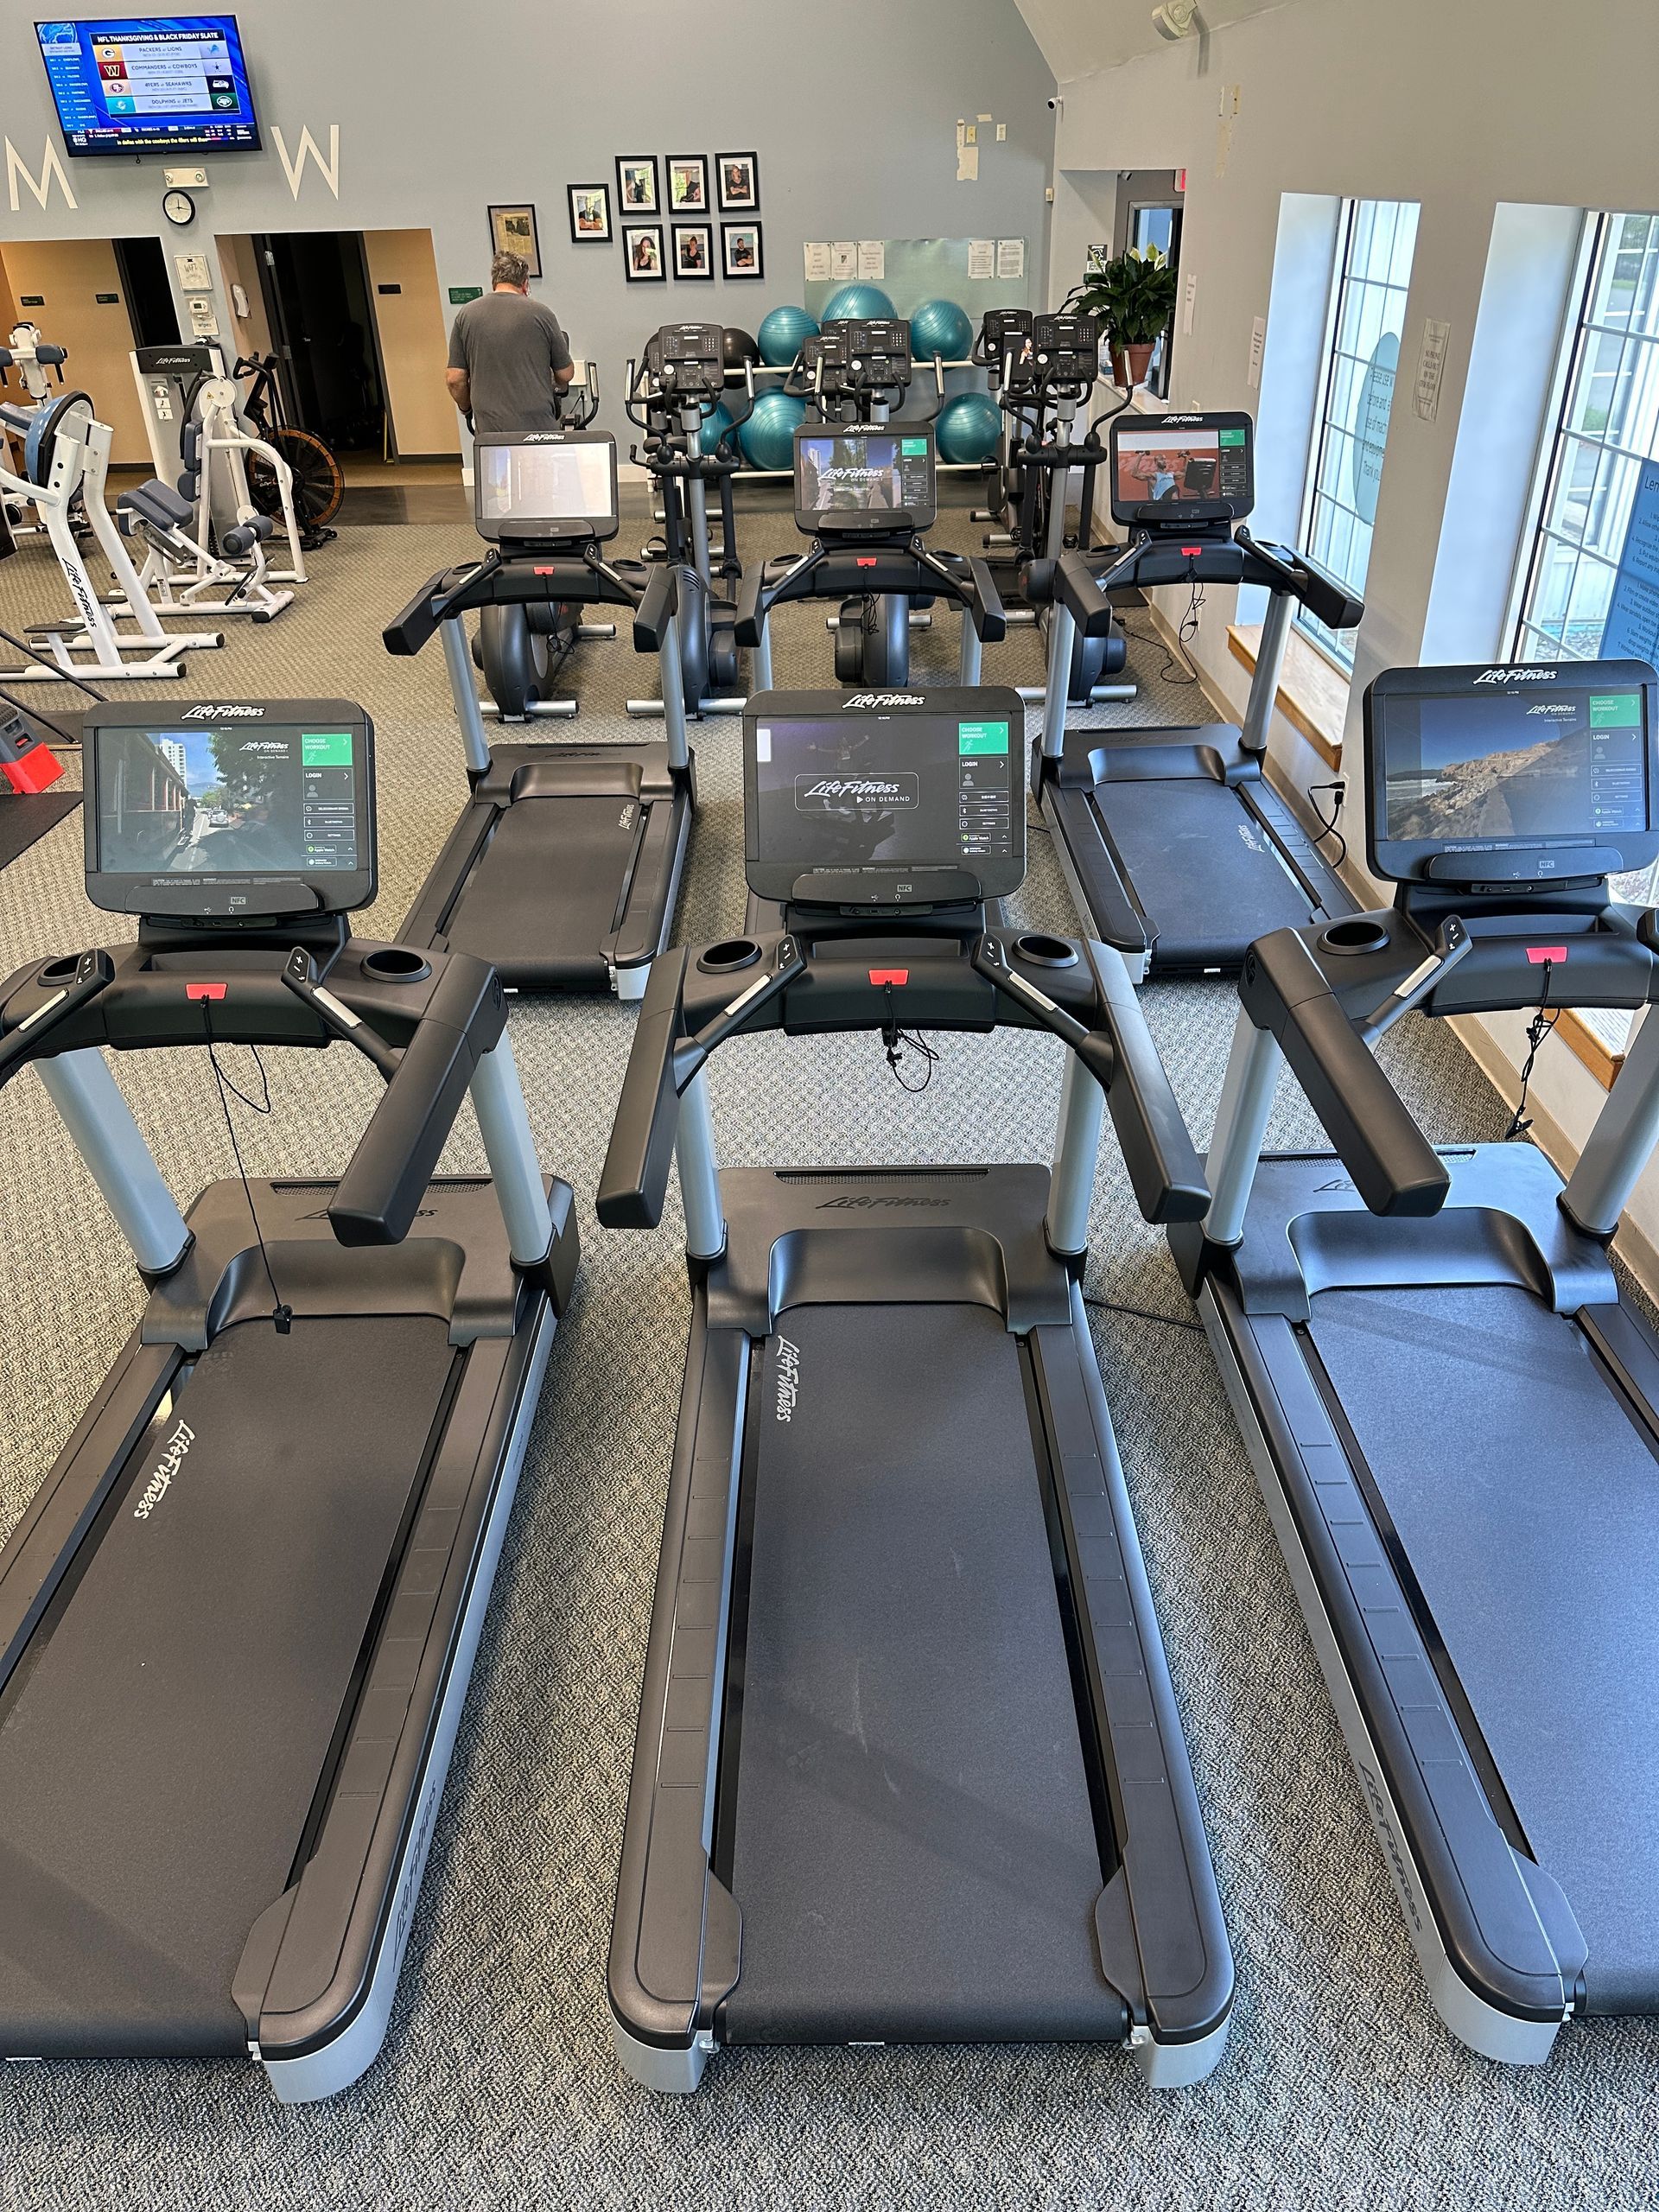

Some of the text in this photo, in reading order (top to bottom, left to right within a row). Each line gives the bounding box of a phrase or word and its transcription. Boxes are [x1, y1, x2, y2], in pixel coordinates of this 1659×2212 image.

[270, 124, 340, 201] W
[4, 134, 78, 211] M
[1472, 668, 1558, 685] LifeFitness
[842, 694, 925, 709] LifeFitness
[1526, 704, 1576, 715] LifeFitness
[181, 705, 266, 721] LifeFitness
[239, 742, 289, 751] LifeFitness
[804, 780, 900, 798] LifeFitness
[816, 1196, 952, 1210] LifeFitness
[776, 1335, 800, 1423] LifeFitness
[134, 1419, 195, 1520] LifeFitness
[1358, 1760, 1423, 1932] LifeFitness
